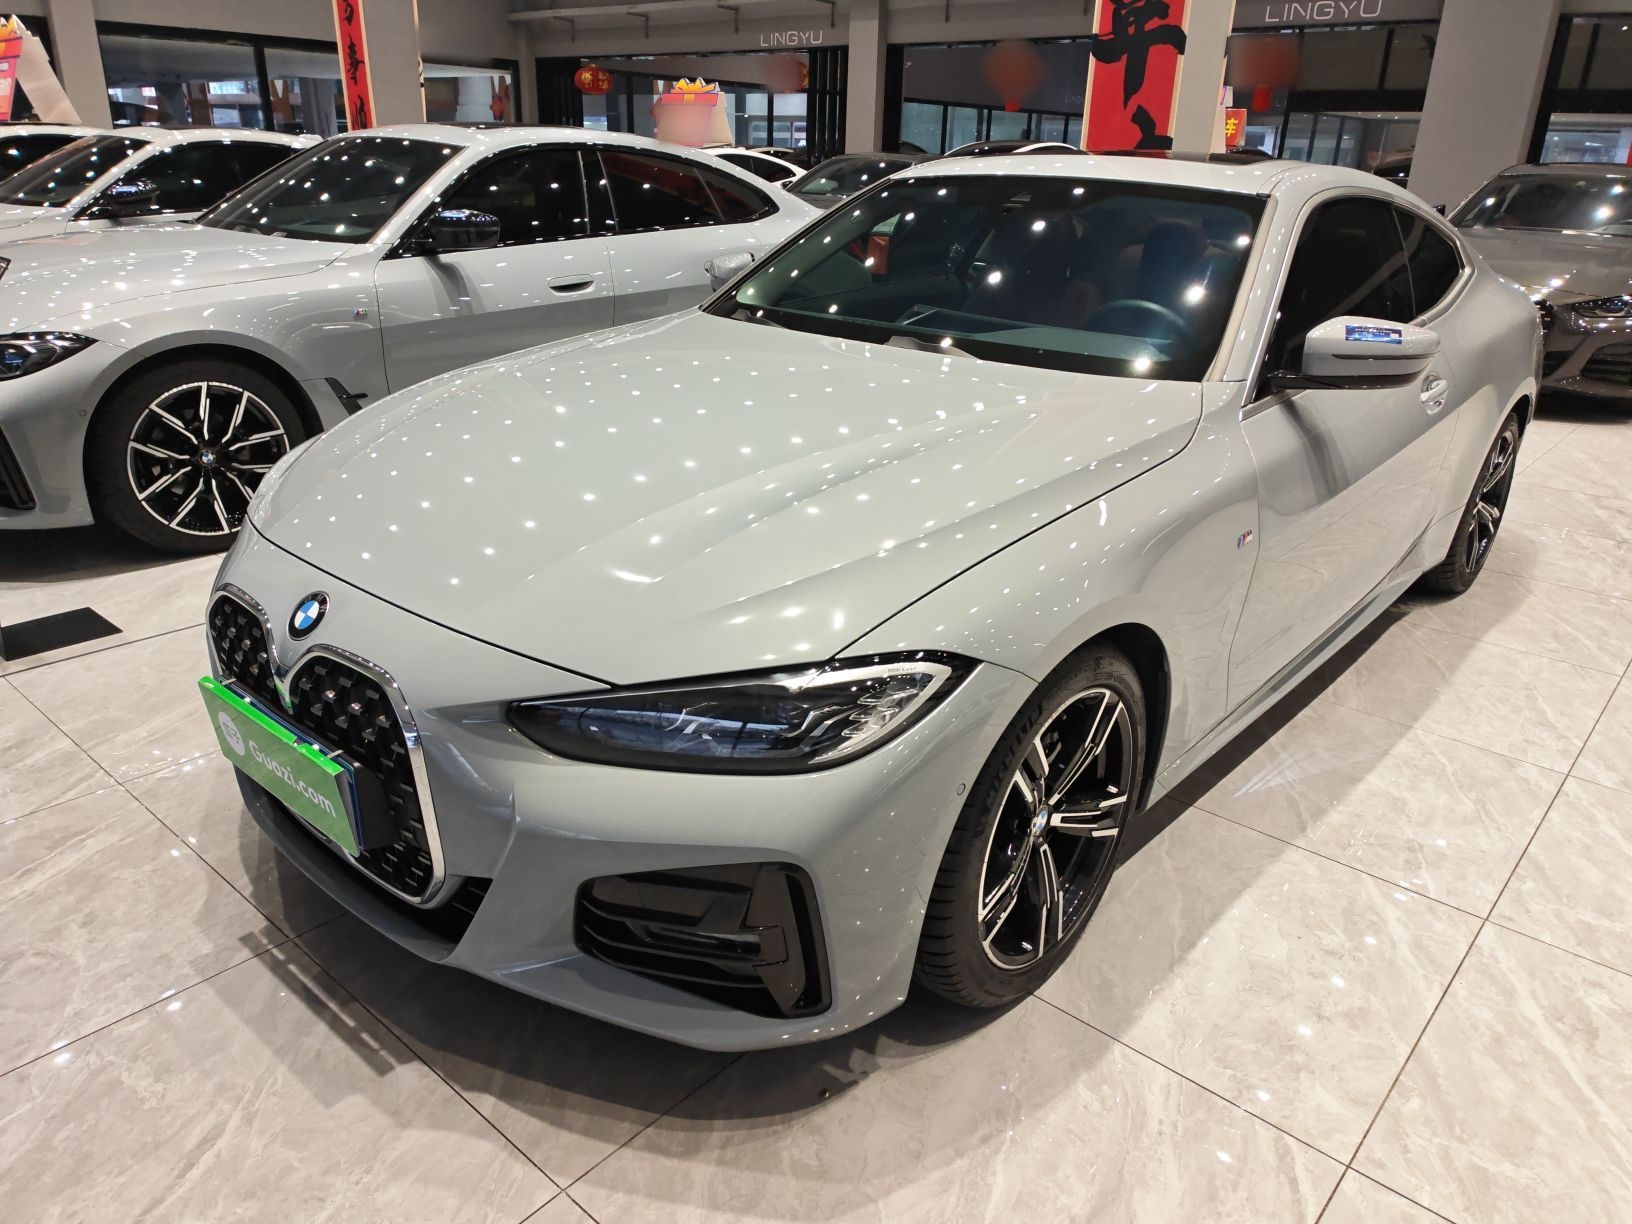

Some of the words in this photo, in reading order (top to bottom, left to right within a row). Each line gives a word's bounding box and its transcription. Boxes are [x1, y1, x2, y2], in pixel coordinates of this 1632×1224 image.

[1265, 0, 1383, 22] LINGYU
[760, 29, 823, 47] LINGYU
[248, 739, 337, 818] Guazi.com
